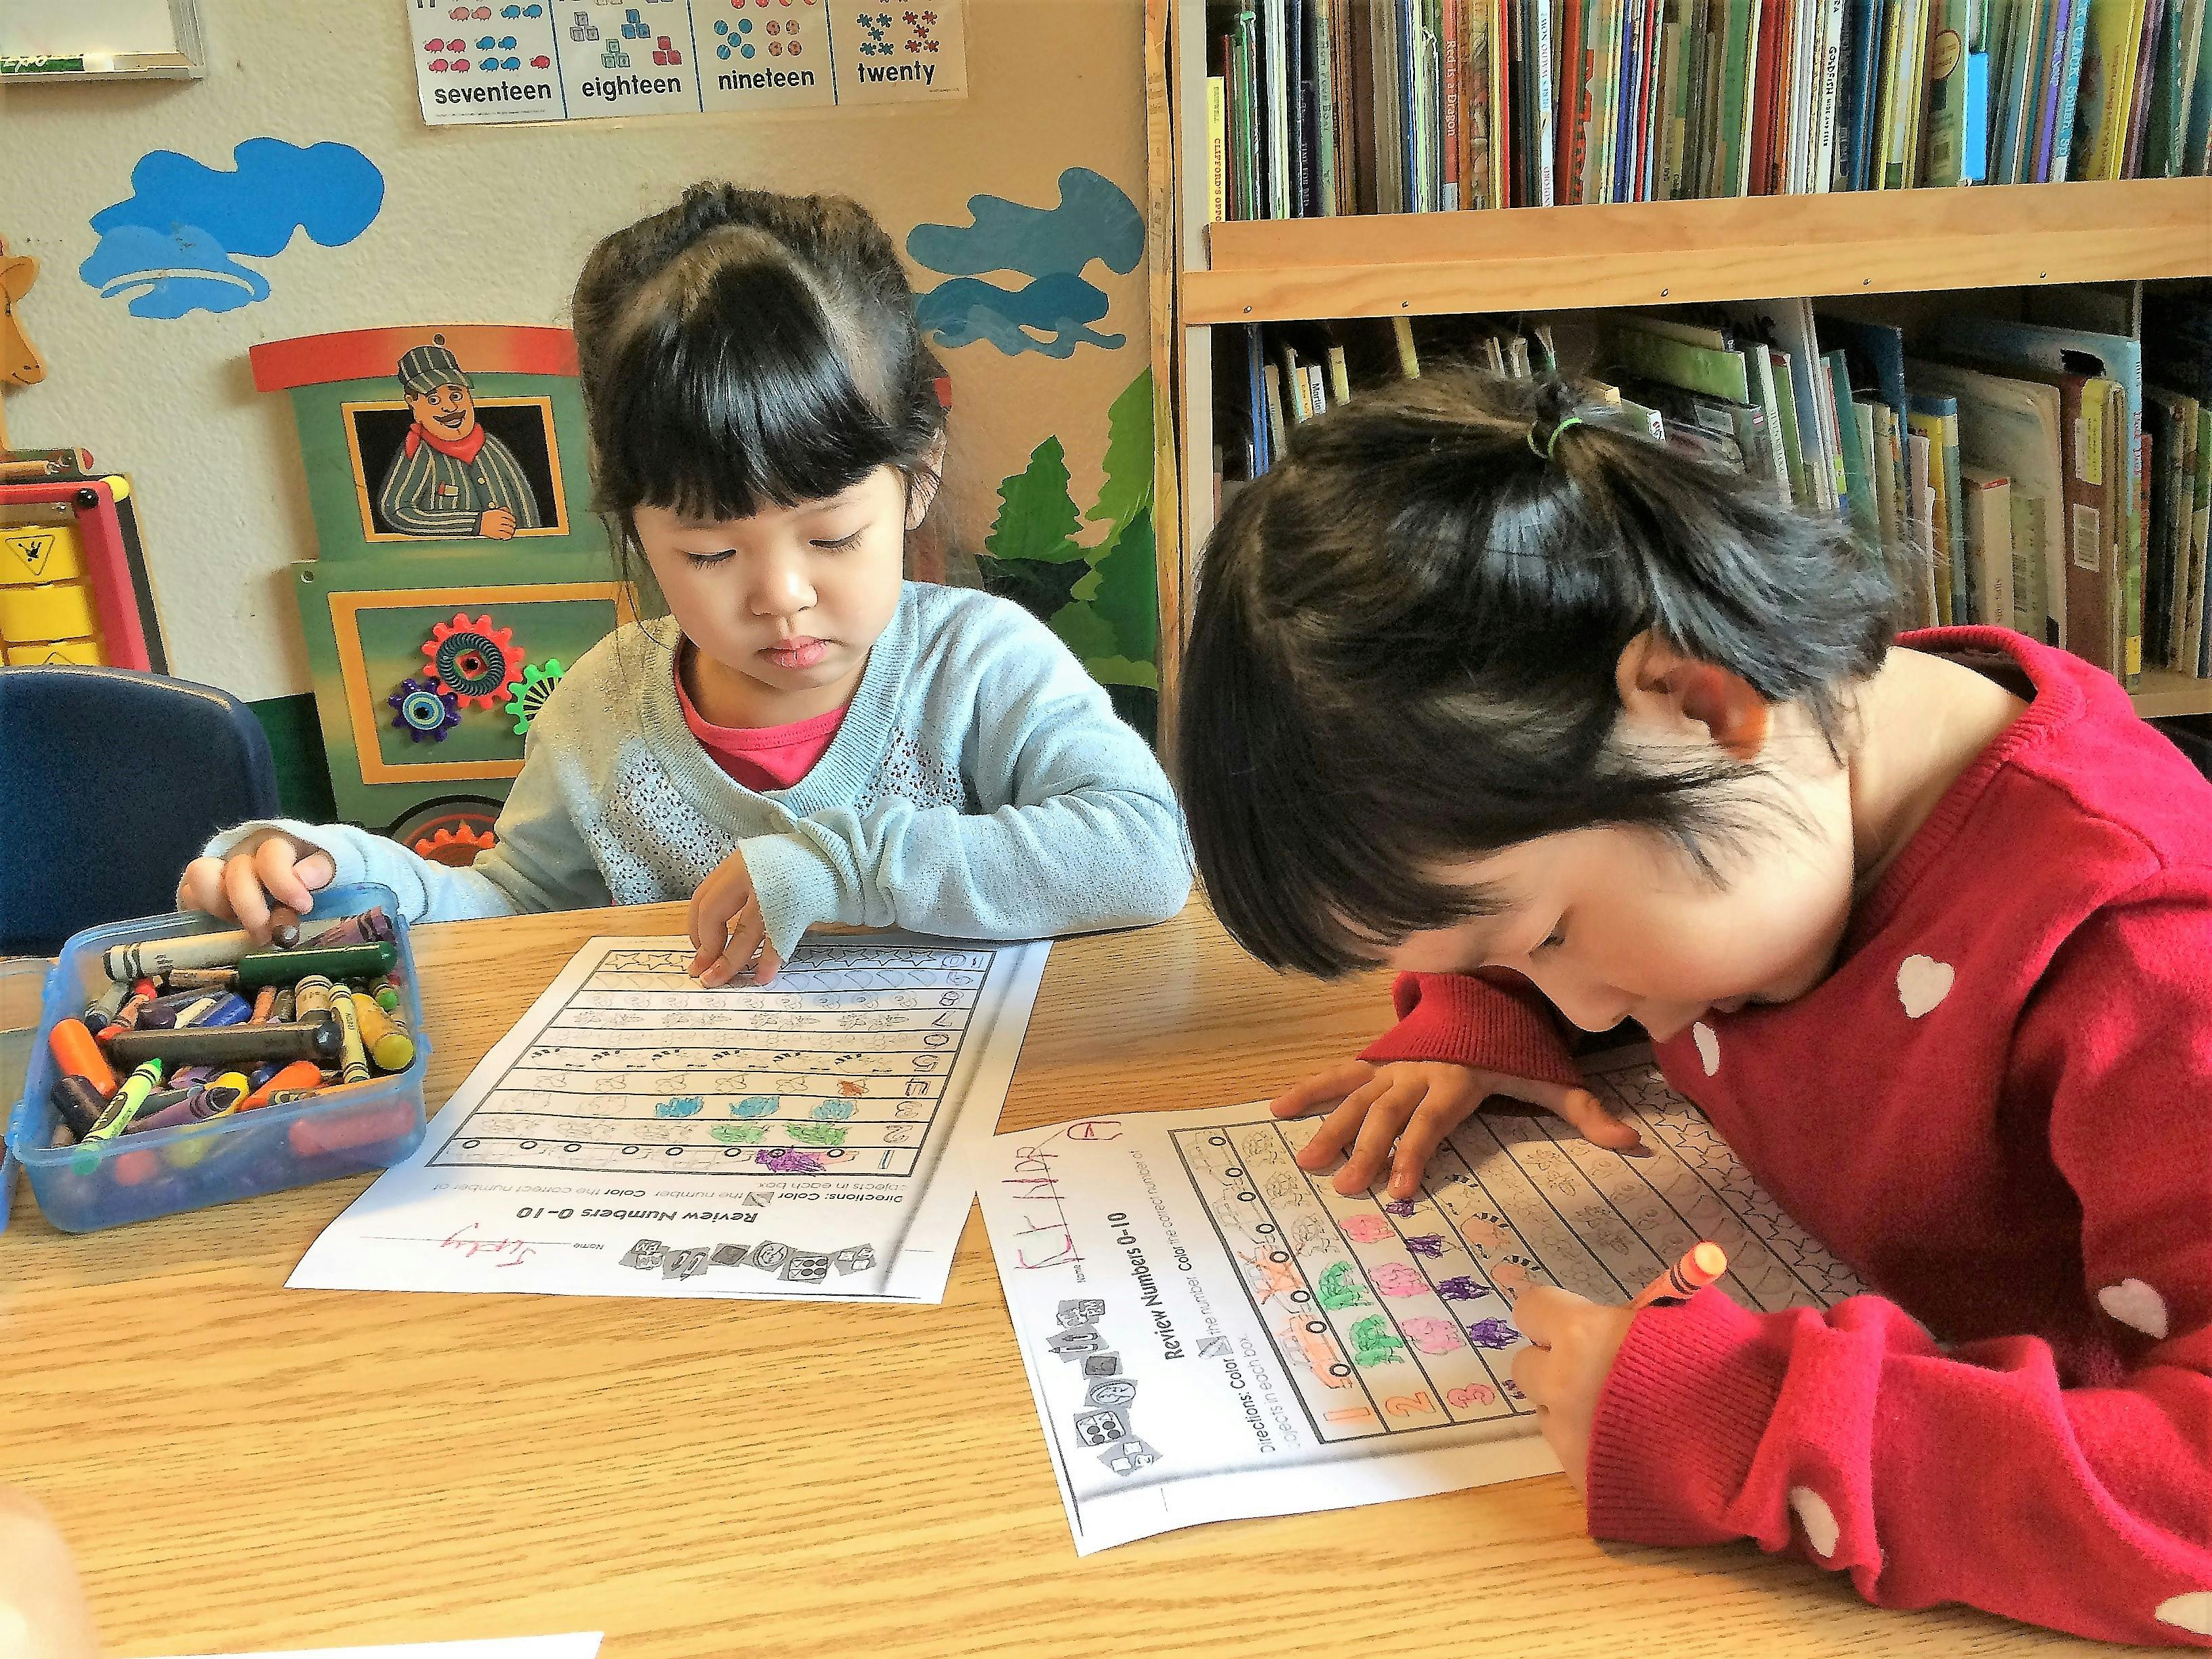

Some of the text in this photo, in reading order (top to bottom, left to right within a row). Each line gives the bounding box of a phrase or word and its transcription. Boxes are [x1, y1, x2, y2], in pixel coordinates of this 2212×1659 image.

[1446, 40, 1456, 62] Red
[718, 68, 815, 90] nineteen
[857, 60, 935, 86] twenty
[1447, 68, 1456, 77] is
[434, 81, 552, 104] seventeen
[582, 74, 682, 102] eighteen
[1446, 94, 1457, 136] Dragon
[946, 972, 973, 986] 9
[939, 991, 964, 1007] 8
[929, 1010, 956, 1027] 7
[911, 1054, 940, 1073] 5
[905, 1078, 931, 1097] 4
[895, 1101, 922, 1120] 3
[883, 1125, 914, 1144] 2
[878, 1149, 895, 1170] 1
[455, 1183, 514, 1195] number
[519, 1184, 575, 1197] correct
[602, 1188, 646, 1199] Color
[777, 1191, 820, 1202] Color
[824, 1191, 903, 1204] Directions:
[516, 1206, 758, 1224] Review Numbers 0-10
[1151, 1195, 1177, 1227] correct
[1164, 1229, 1181, 1244] the
[573, 1242, 605, 1252] Name
[1171, 1245, 1193, 1271] Color
[1073, 1265, 1087, 1283] Name
[1107, 1212, 1185, 1360] Review Numbers 0-10
[1204, 1316, 1222, 1334] the
[1222, 1357, 1246, 1389] Color
[1248, 1359, 1271, 1391] each
[1261, 1393, 1279, 1404] in
[1385, 1391, 1437, 1418] 2
[1446, 1383, 1495, 1410] 3
[1237, 1391, 1275, 1454] Directions:
[1322, 1406, 1371, 1421] 1
